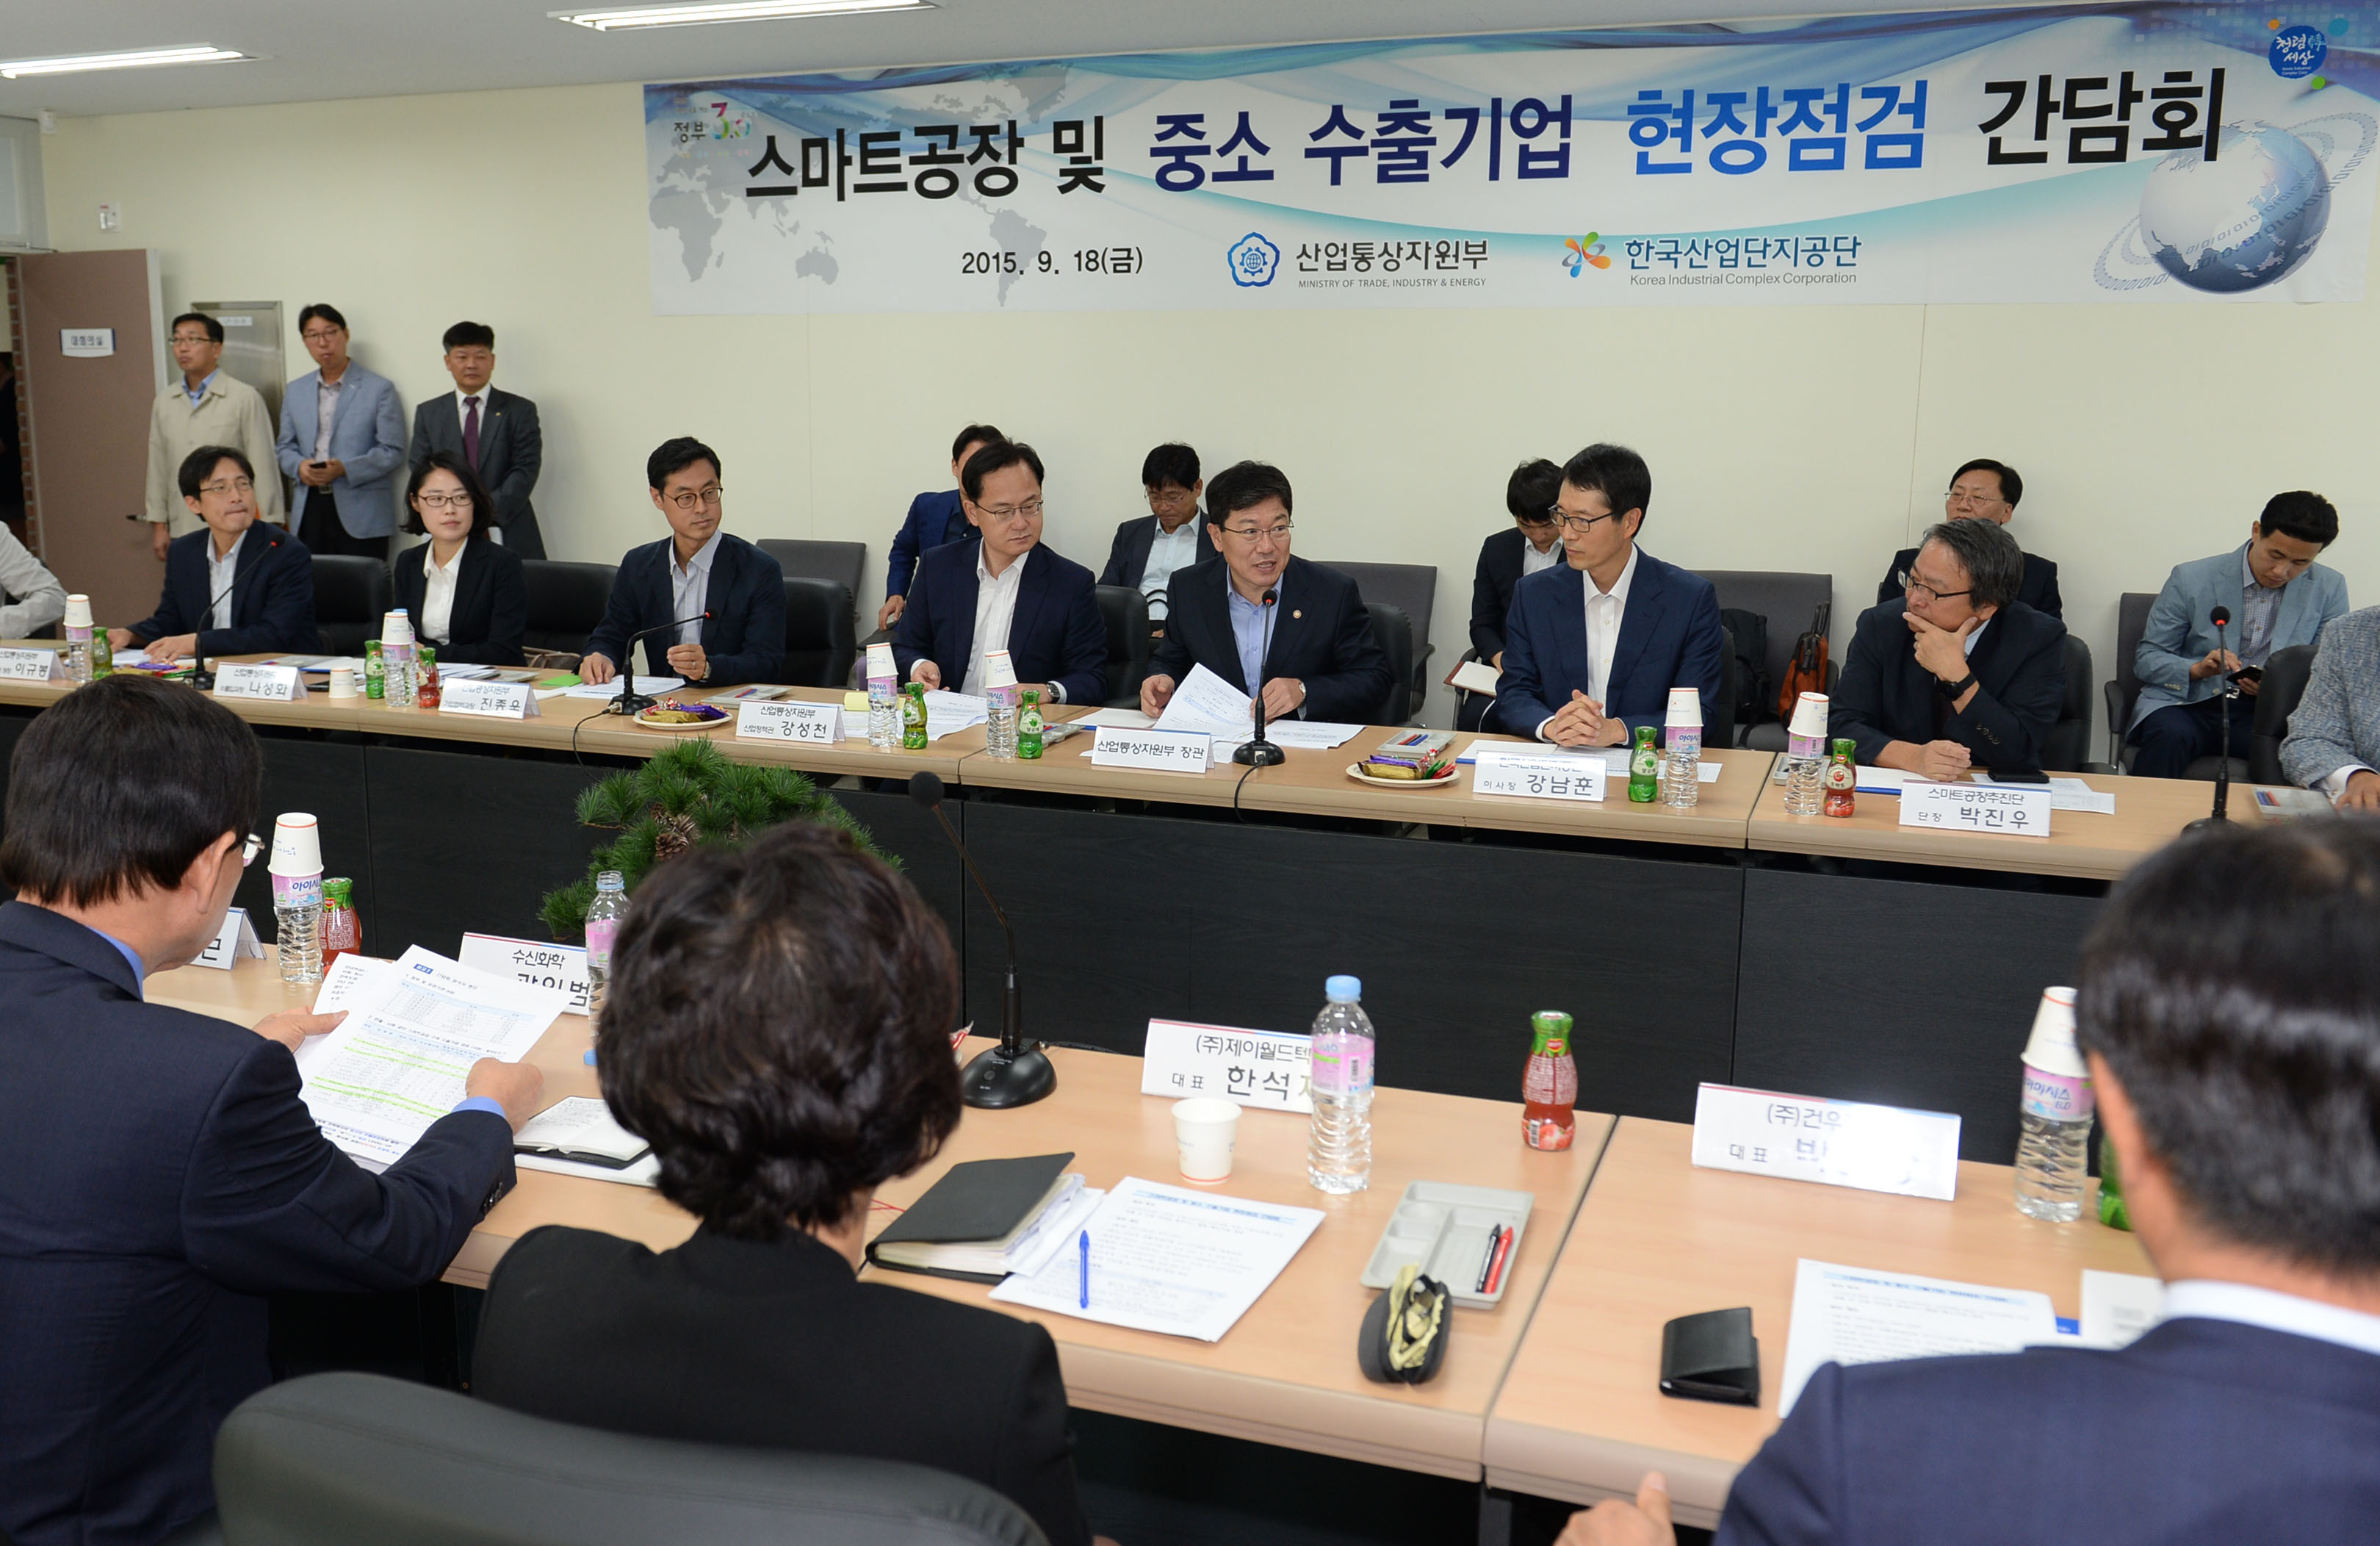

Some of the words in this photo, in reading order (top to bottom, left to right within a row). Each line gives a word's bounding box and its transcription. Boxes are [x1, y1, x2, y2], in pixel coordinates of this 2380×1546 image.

[2283, 49, 2315, 65] 세상
[674, 121, 706, 143] 정부
[746, 119, 1025, 201] 스마트공장
[1052, 115, 1106, 195] 및
[1150, 110, 1274, 193] 중소
[1304, 93, 1573, 187] 수출기업
[1626, 79, 1929, 176] 현장점검
[1977, 66, 2226, 165] 간담회
[962, 251, 1025, 275] 2015.
[1037, 250, 1060, 275] 9.
[1073, 246, 1144, 275] 18(금)
[1296, 240, 1488, 273] 산업통상자원부
[1625, 235, 1862, 270] 한국산업단지공단
[1298, 279, 1341, 288] MINISTRY
[1342, 279, 1355, 288] OF
[1358, 278, 1391, 289] TRADE,
[1392, 278, 1438, 287] INDUSTRY
[1440, 278, 1448, 287] &
[1449, 277, 1487, 287] ENERGY
[1630, 273, 1666, 286] Korea
[1668, 273, 1723, 285] Industrial
[1726, 273, 1781, 287] Complex
[1783, 272, 1857, 286] Corporation
[760, 705, 816, 719] 산업통상자원부
[780, 720, 827, 739] 강성천
[1097, 740, 1175, 757] 산업통상자원부
[1180, 746, 1205, 760] 장관
[1483, 780, 1516, 791] 이사장
[1526, 774, 1593, 796] 강남훈
[1928, 788, 2025, 806] 스마트공장추진단
[1918, 811, 1942, 822] 단장
[1960, 807, 2030, 829] 박진우
[511, 948, 566, 970] 수신화학
[1171, 1072, 1205, 1090] 대표
[1729, 1143, 1768, 1163] 대표
